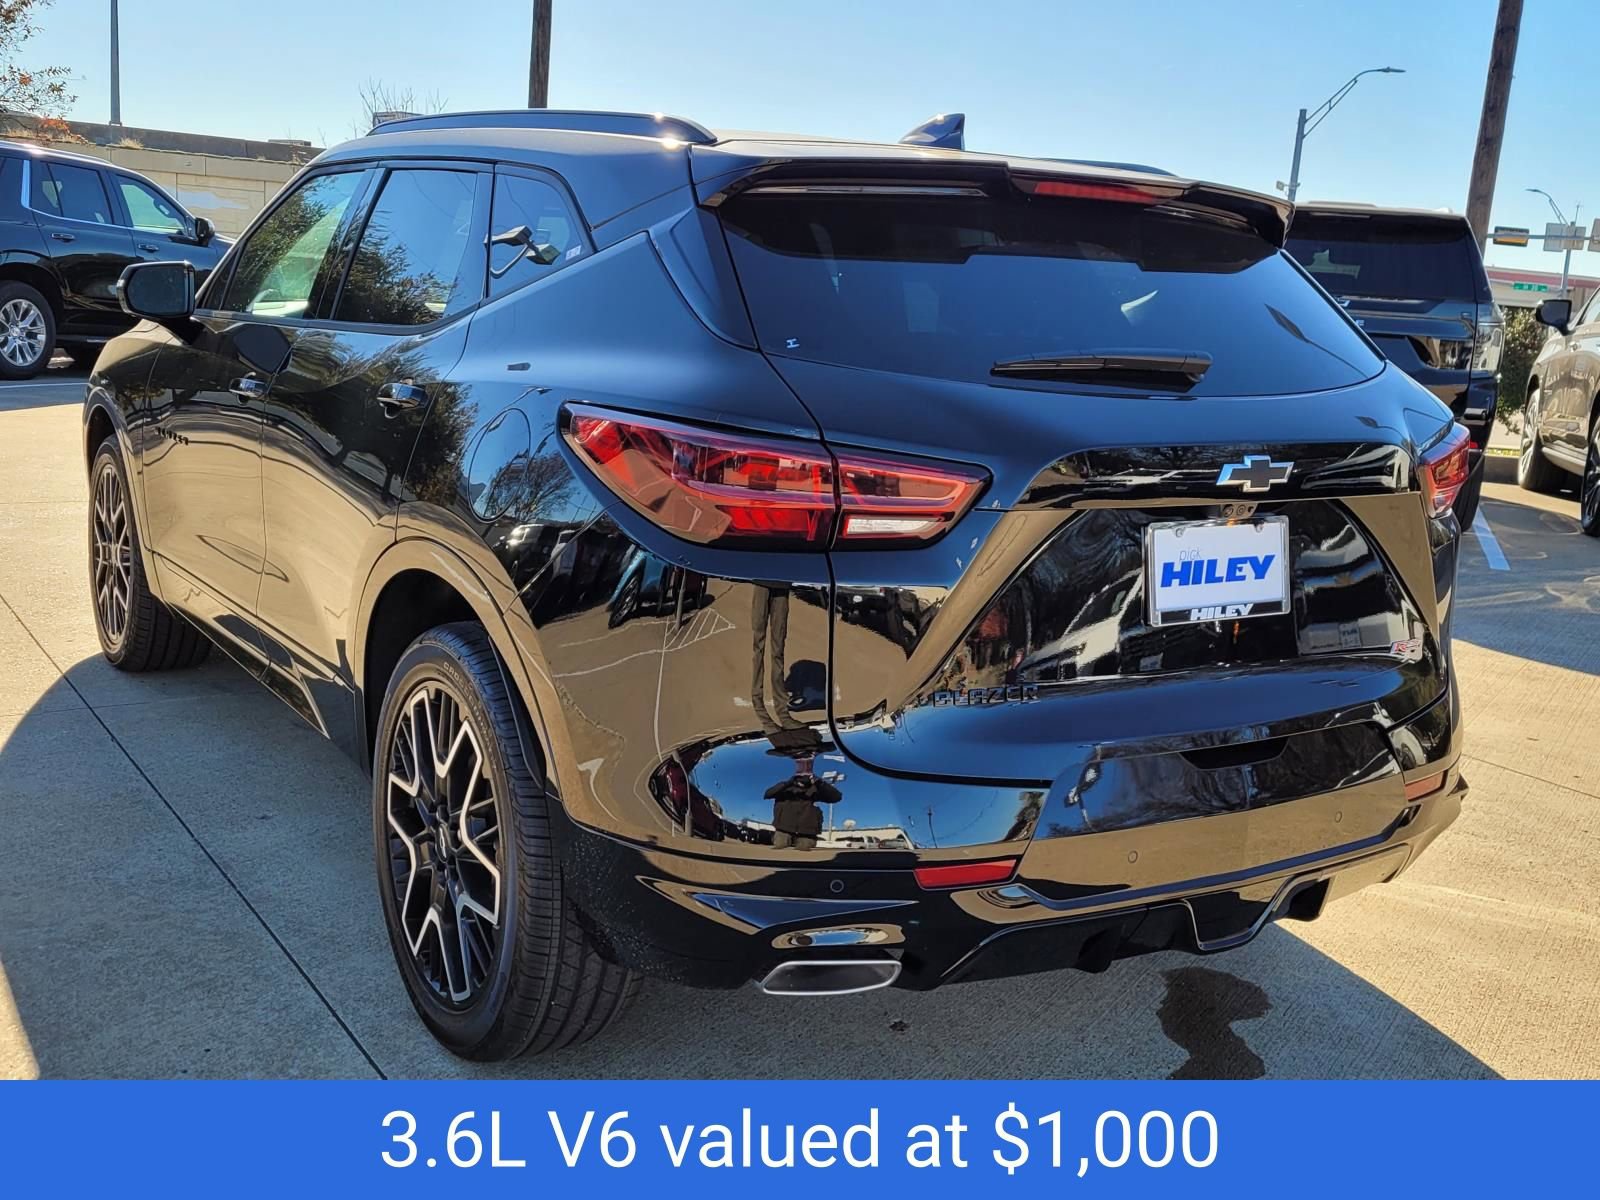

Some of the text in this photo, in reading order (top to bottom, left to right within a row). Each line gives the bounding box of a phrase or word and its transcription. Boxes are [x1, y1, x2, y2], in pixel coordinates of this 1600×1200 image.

[1160, 554, 1276, 588] HILEY
[1190, 603, 1254, 621] HILEY
[933, 685, 1041, 708] BLAZER
